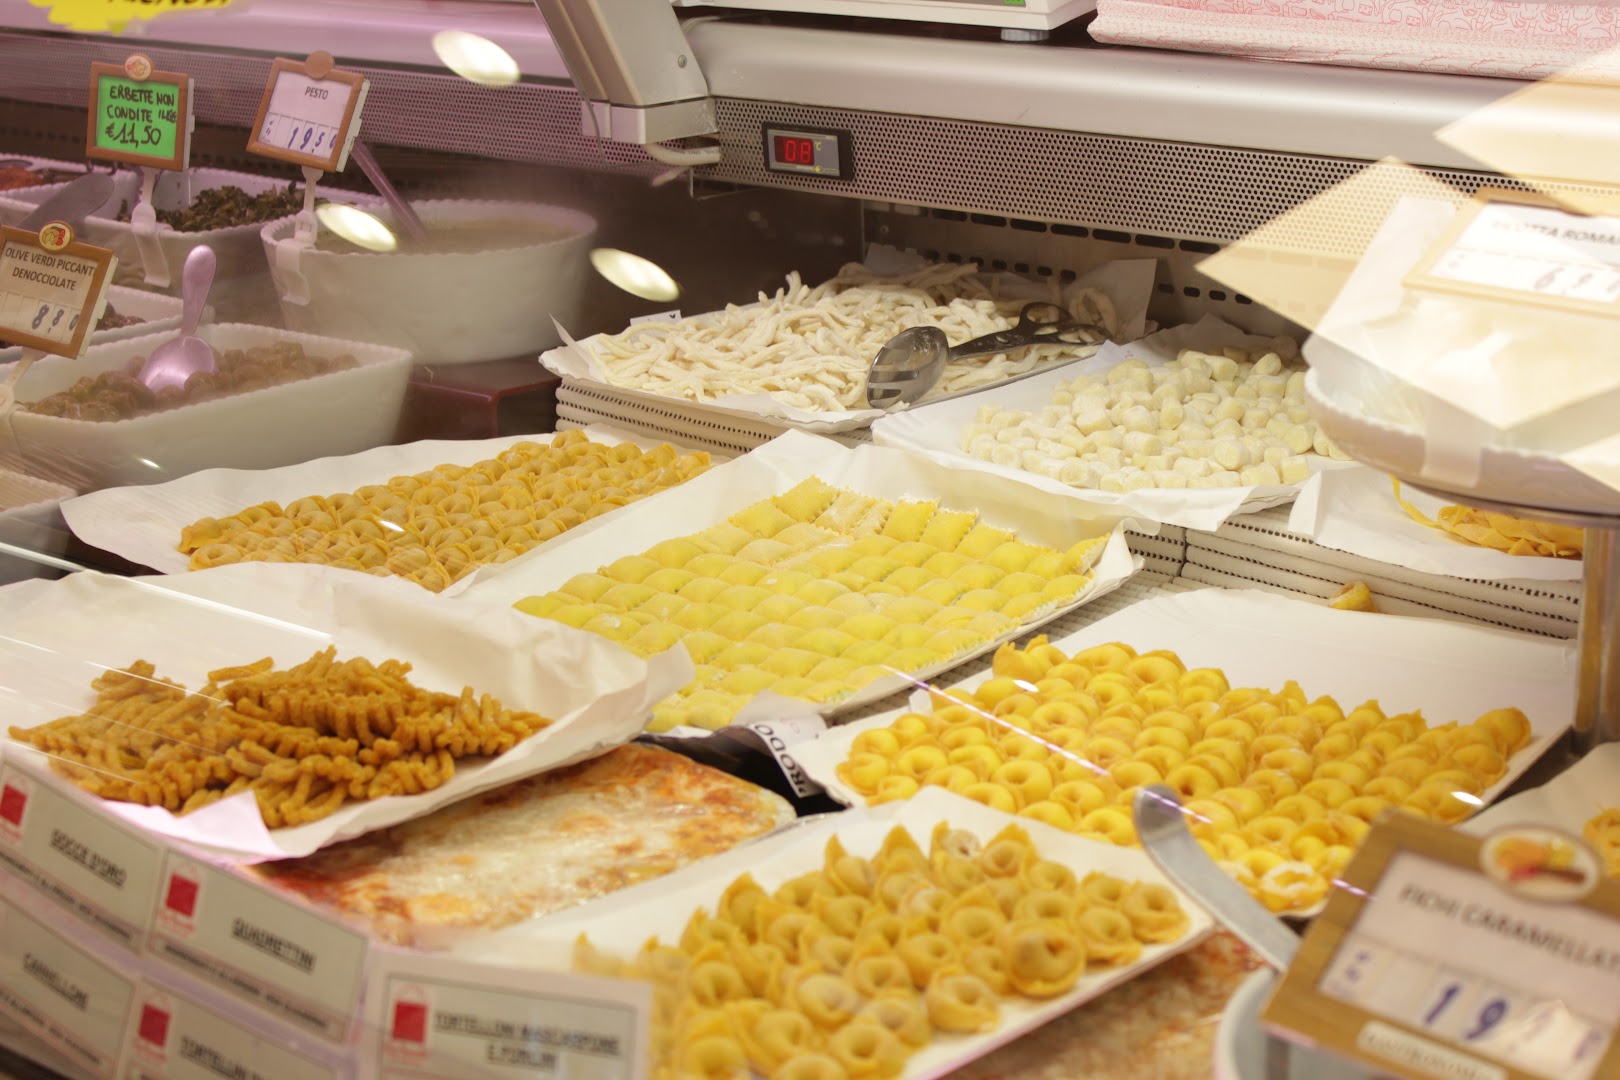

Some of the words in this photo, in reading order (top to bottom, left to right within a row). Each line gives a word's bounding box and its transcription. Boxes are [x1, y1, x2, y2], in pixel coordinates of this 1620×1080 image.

[110, 85, 153, 104] ERBETTE
[156, 92, 174, 106] NON
[305, 86, 328, 100] PESTO
[107, 104, 152, 123] CONDITE
[785, 140, 811, 163] 08
[5, 247, 30, 262] OLIVE
[31, 253, 56, 268] VERDI
[12, 266, 77, 291] DENOCCIOLATE
